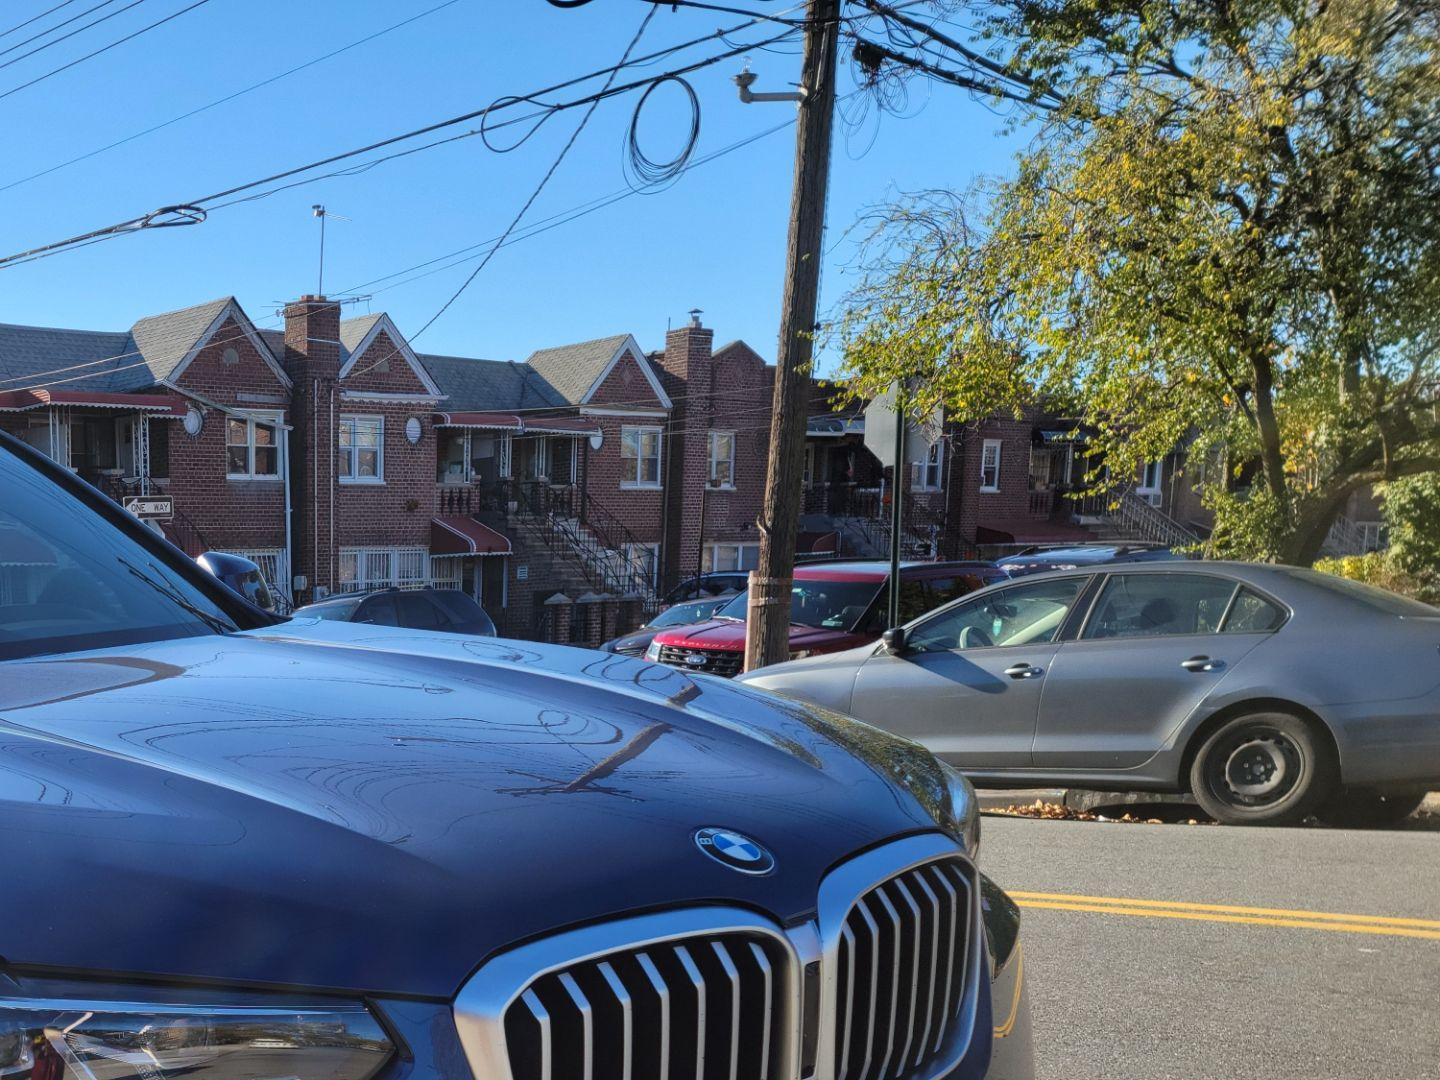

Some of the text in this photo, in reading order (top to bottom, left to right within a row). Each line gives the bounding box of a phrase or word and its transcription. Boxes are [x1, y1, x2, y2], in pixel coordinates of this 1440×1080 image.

[130, 502, 169, 513] ONE WAY
[673, 639, 739, 649] EXPLORER
